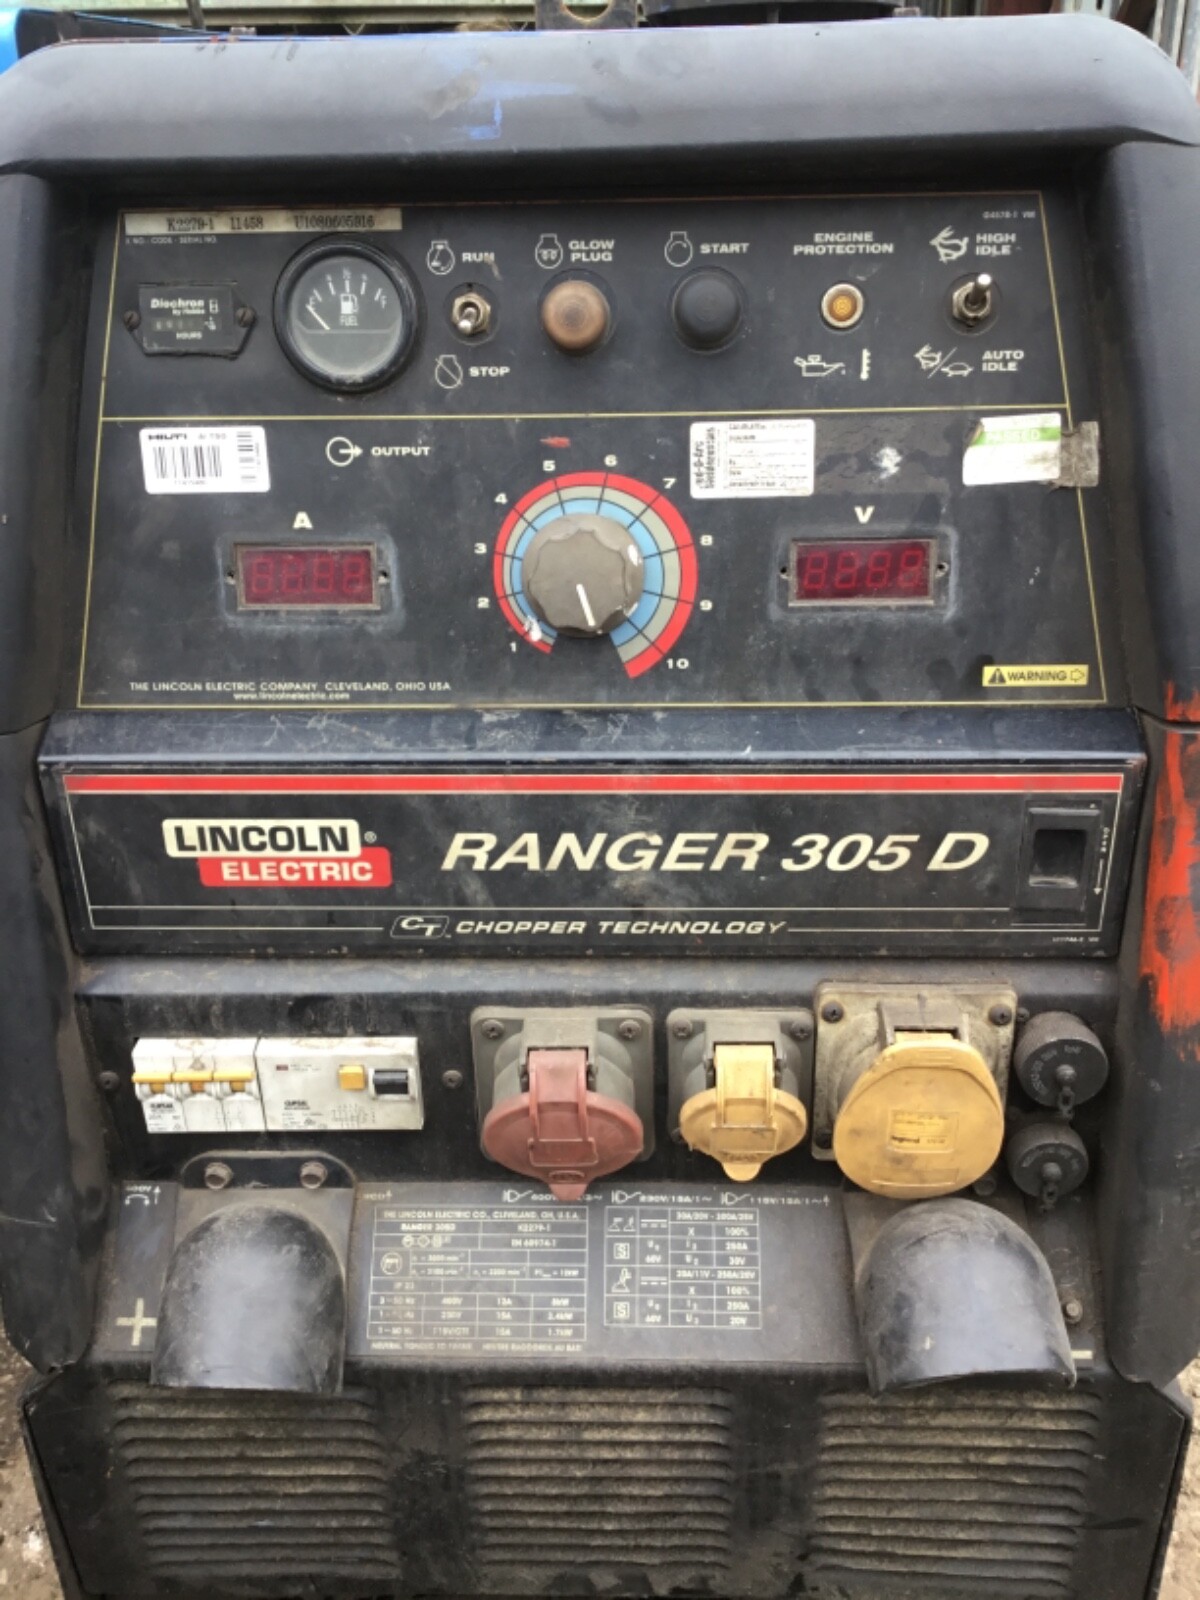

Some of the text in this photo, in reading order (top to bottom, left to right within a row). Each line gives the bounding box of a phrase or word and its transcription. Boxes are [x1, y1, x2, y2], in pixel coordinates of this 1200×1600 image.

[814, 232, 874, 243] ENGINE
[975, 233, 1016, 243] HIGH
[568, 239, 615, 251] GLOW
[700, 242, 750, 254] START
[793, 243, 895, 256] PROTECTION
[975, 244, 1012, 256] IDLE
[462, 252, 495, 263] RUN
[570, 251, 613, 262] PLUG
[340, 315, 359, 327] FUEL
[176, 331, 203, 340] HOURS
[982, 349, 1025, 361] AUTO
[469, 366, 510, 377] STOP
[981, 360, 1018, 372] IDLE
[371, 446, 431, 457] OUTPUT
[543, 460, 556, 472] 5
[604, 454, 617, 467] 6
[662, 478, 676, 489] 7
[495, 493, 508, 505] 4
[292, 511, 313, 530] A
[854, 506, 875, 524] V
[700, 535, 713, 546] 8
[474, 543, 487, 554] 3
[477, 597, 490, 609] 2
[700, 600, 713, 611] 9
[510, 642, 518, 652] 1
[667, 658, 689, 669] 10
[1007, 670, 1067, 681] WARNING
[130, 681, 149, 692] THE
[152, 681, 202, 692] LINCOLN
[205, 681, 256, 692] ELECTRIC
[395, 681, 426, 692] OHIO
[429, 681, 451, 692] USA
[233, 692, 350, 701] www.lincolnelectric.com
[174, 825, 350, 853] LINCOLN
[441, 832, 990, 872] RANGER 305 D
[221, 861, 374, 882] ELECTRIC
[456, 920, 587, 935] CHOPPER
[598, 920, 787, 935] TECHNOLOGY
[398, 1210, 434, 1219] LINCOLN
[434, 1210, 471, 1219] ELECTRIC
